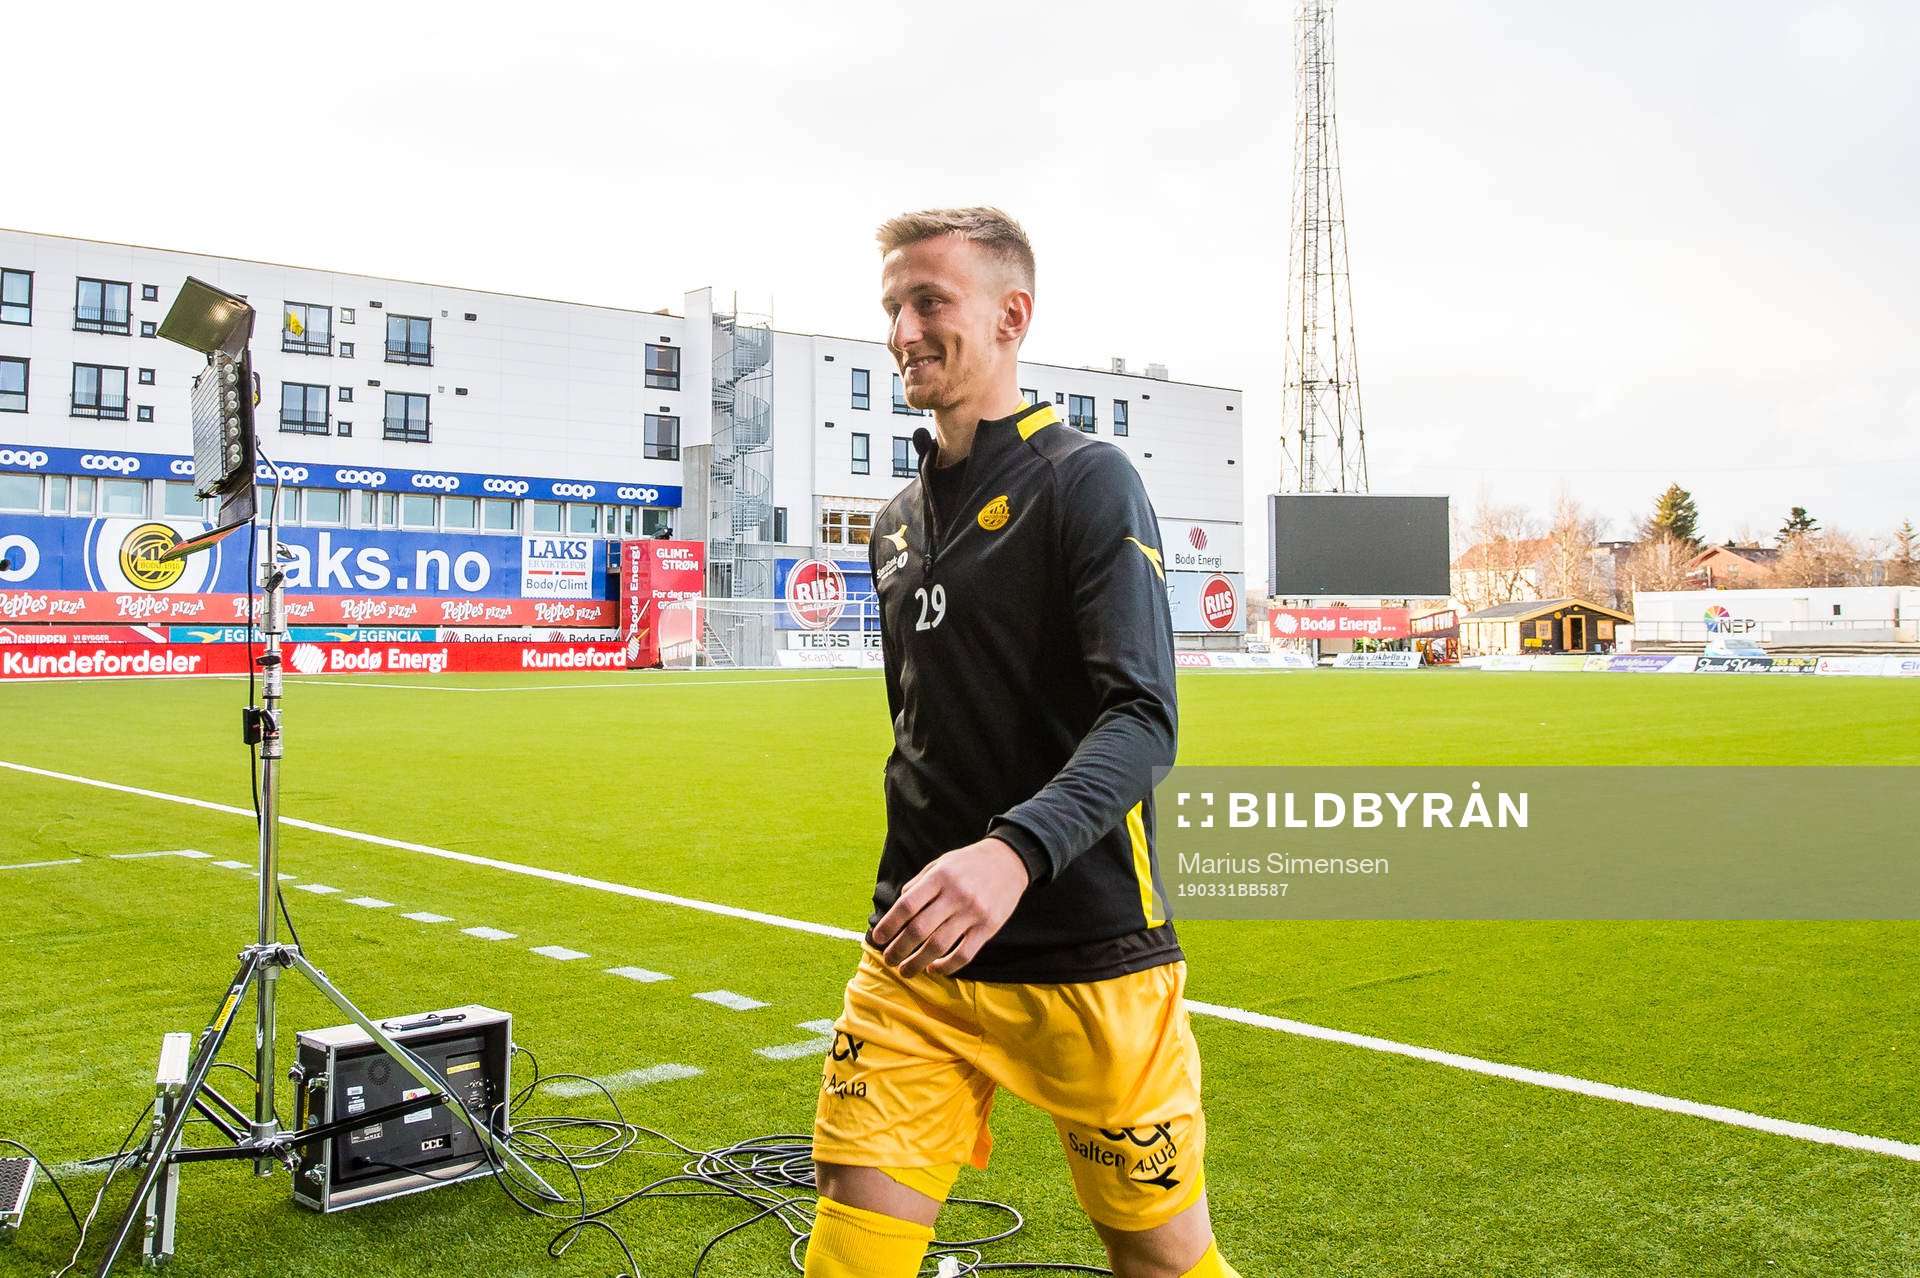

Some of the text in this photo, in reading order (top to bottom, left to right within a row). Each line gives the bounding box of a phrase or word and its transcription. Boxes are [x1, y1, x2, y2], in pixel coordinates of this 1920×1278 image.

[81, 455, 140, 474] coop
[171, 460, 195, 475] co
[336, 469, 386, 487] coop
[412, 473, 459, 491] coop
[484, 478, 529, 495] coop
[552, 482, 595, 499] coop
[617, 487, 658, 502] coop
[529, 539, 587, 560] LAKS
[656, 547, 694, 560] GLIMT-
[662, 560, 699, 571] STRØM
[1198, 554, 1222, 569] Energi
[116, 594, 170, 618] Peppes
[341, 599, 386, 621] Peppes
[441, 600, 484, 621] Peppes
[915, 584, 947, 632] 29
[1205, 590, 1233, 615] RIIS
[535, 602, 574, 622] Peppes
[1720, 619, 1756, 633] NEP
[359, 630, 421, 642] EGENCIA
[3, 649, 201, 674] Kundefordeler
[331, 647, 448, 674] Bodø Energi
[1068, 1132, 1126, 1170] Salten
[1130, 1142, 1177, 1175] Aqua
